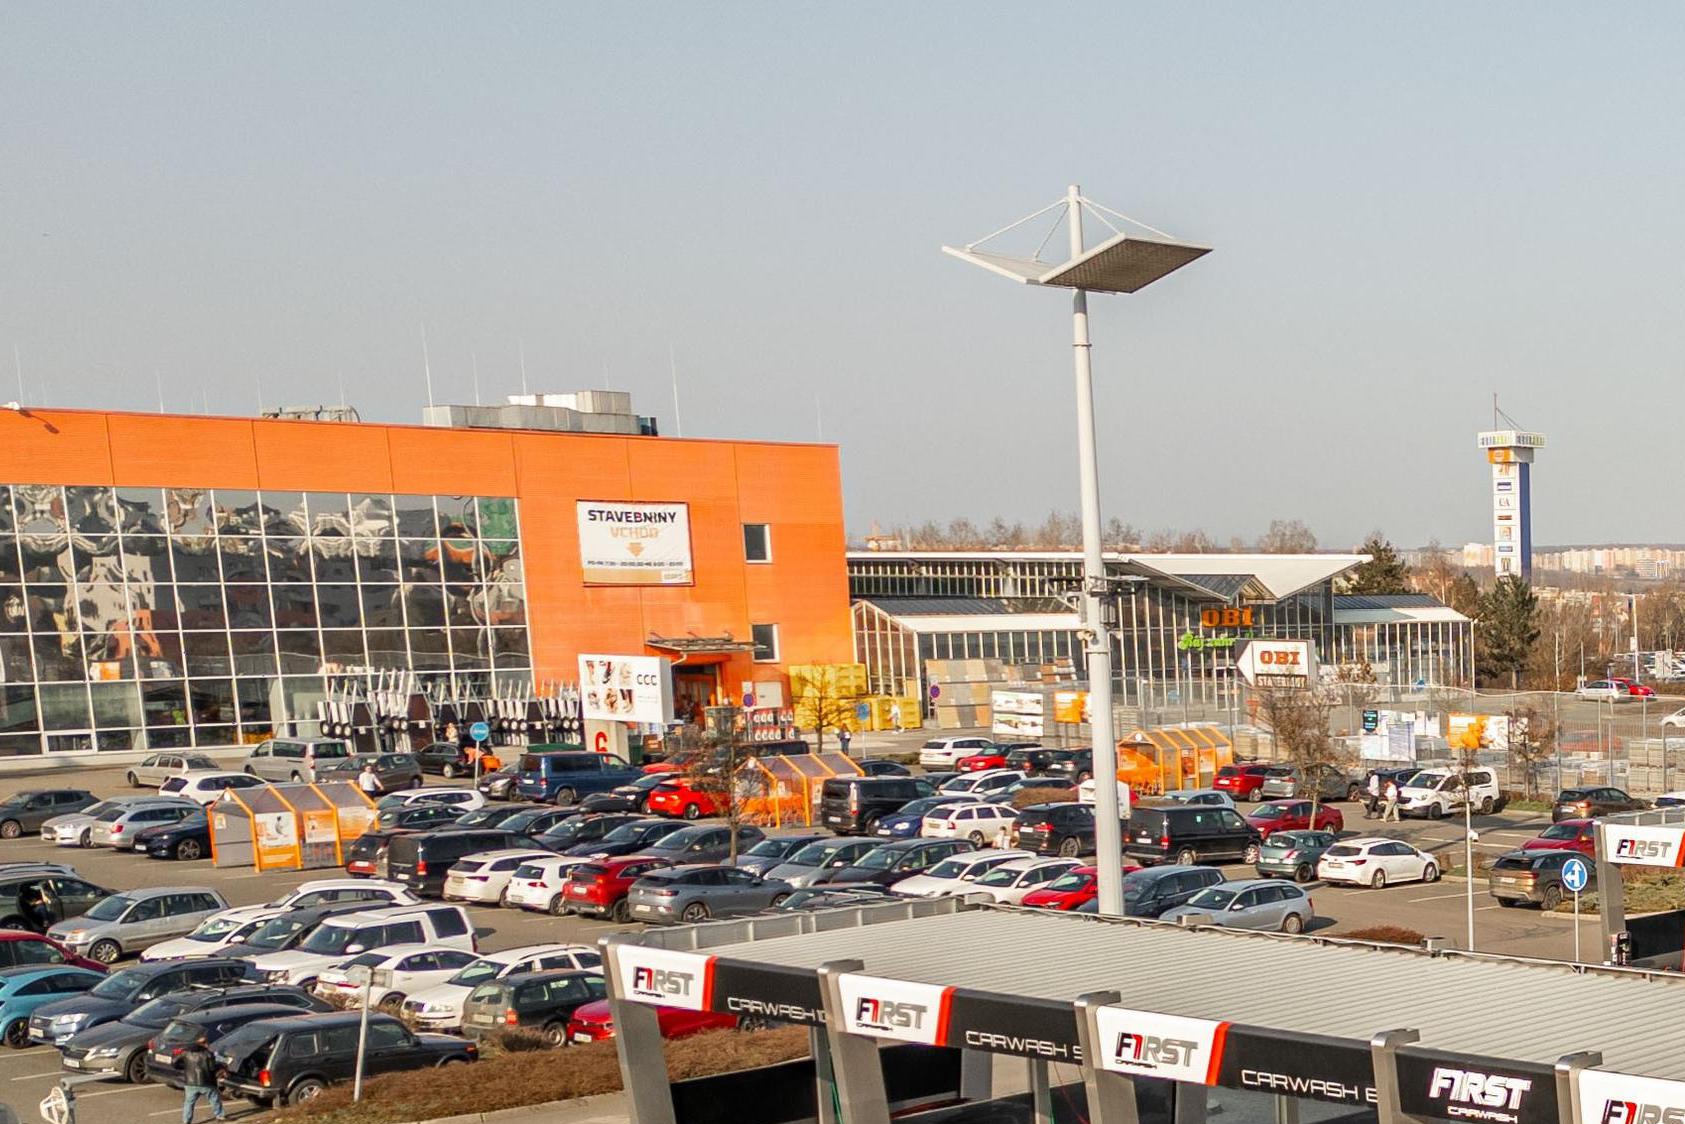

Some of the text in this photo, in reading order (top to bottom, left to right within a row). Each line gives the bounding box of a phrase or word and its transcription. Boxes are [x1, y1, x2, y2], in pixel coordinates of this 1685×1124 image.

[587, 510, 677, 523] STAVEBNINY
[1202, 607, 1254, 627] OBI
[1259, 650, 1301, 665] OBI
[636, 673, 658, 686] CCC
[726, 997, 815, 1021] CARWASH
[965, 1030, 1068, 1058] CARWASH
[1241, 1069, 1359, 1099] CARWASH
[1447, 1105, 1518, 1124] CARWASH
